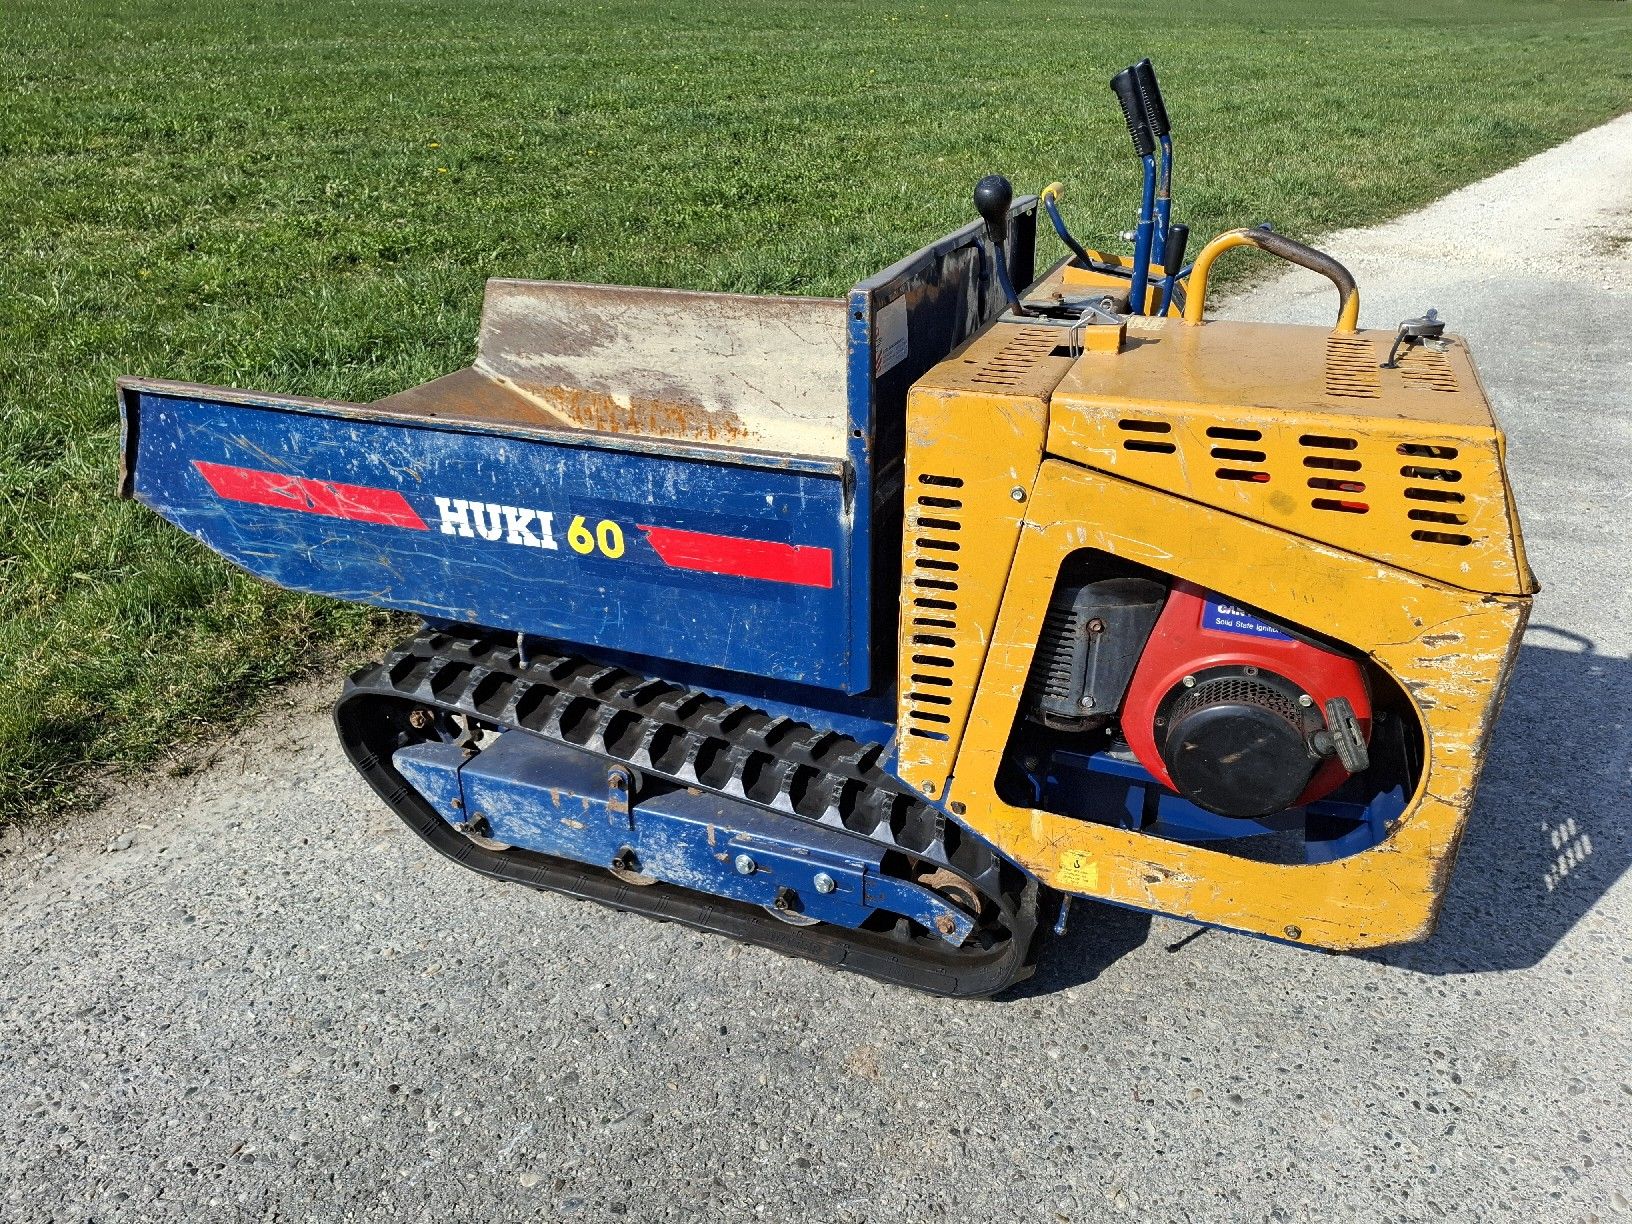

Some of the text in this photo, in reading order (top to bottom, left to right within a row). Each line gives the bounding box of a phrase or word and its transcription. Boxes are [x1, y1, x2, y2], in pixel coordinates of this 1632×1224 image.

[434, 496, 625, 559] HUKI 60
[1215, 618, 1281, 633] Solid State Ignitio
